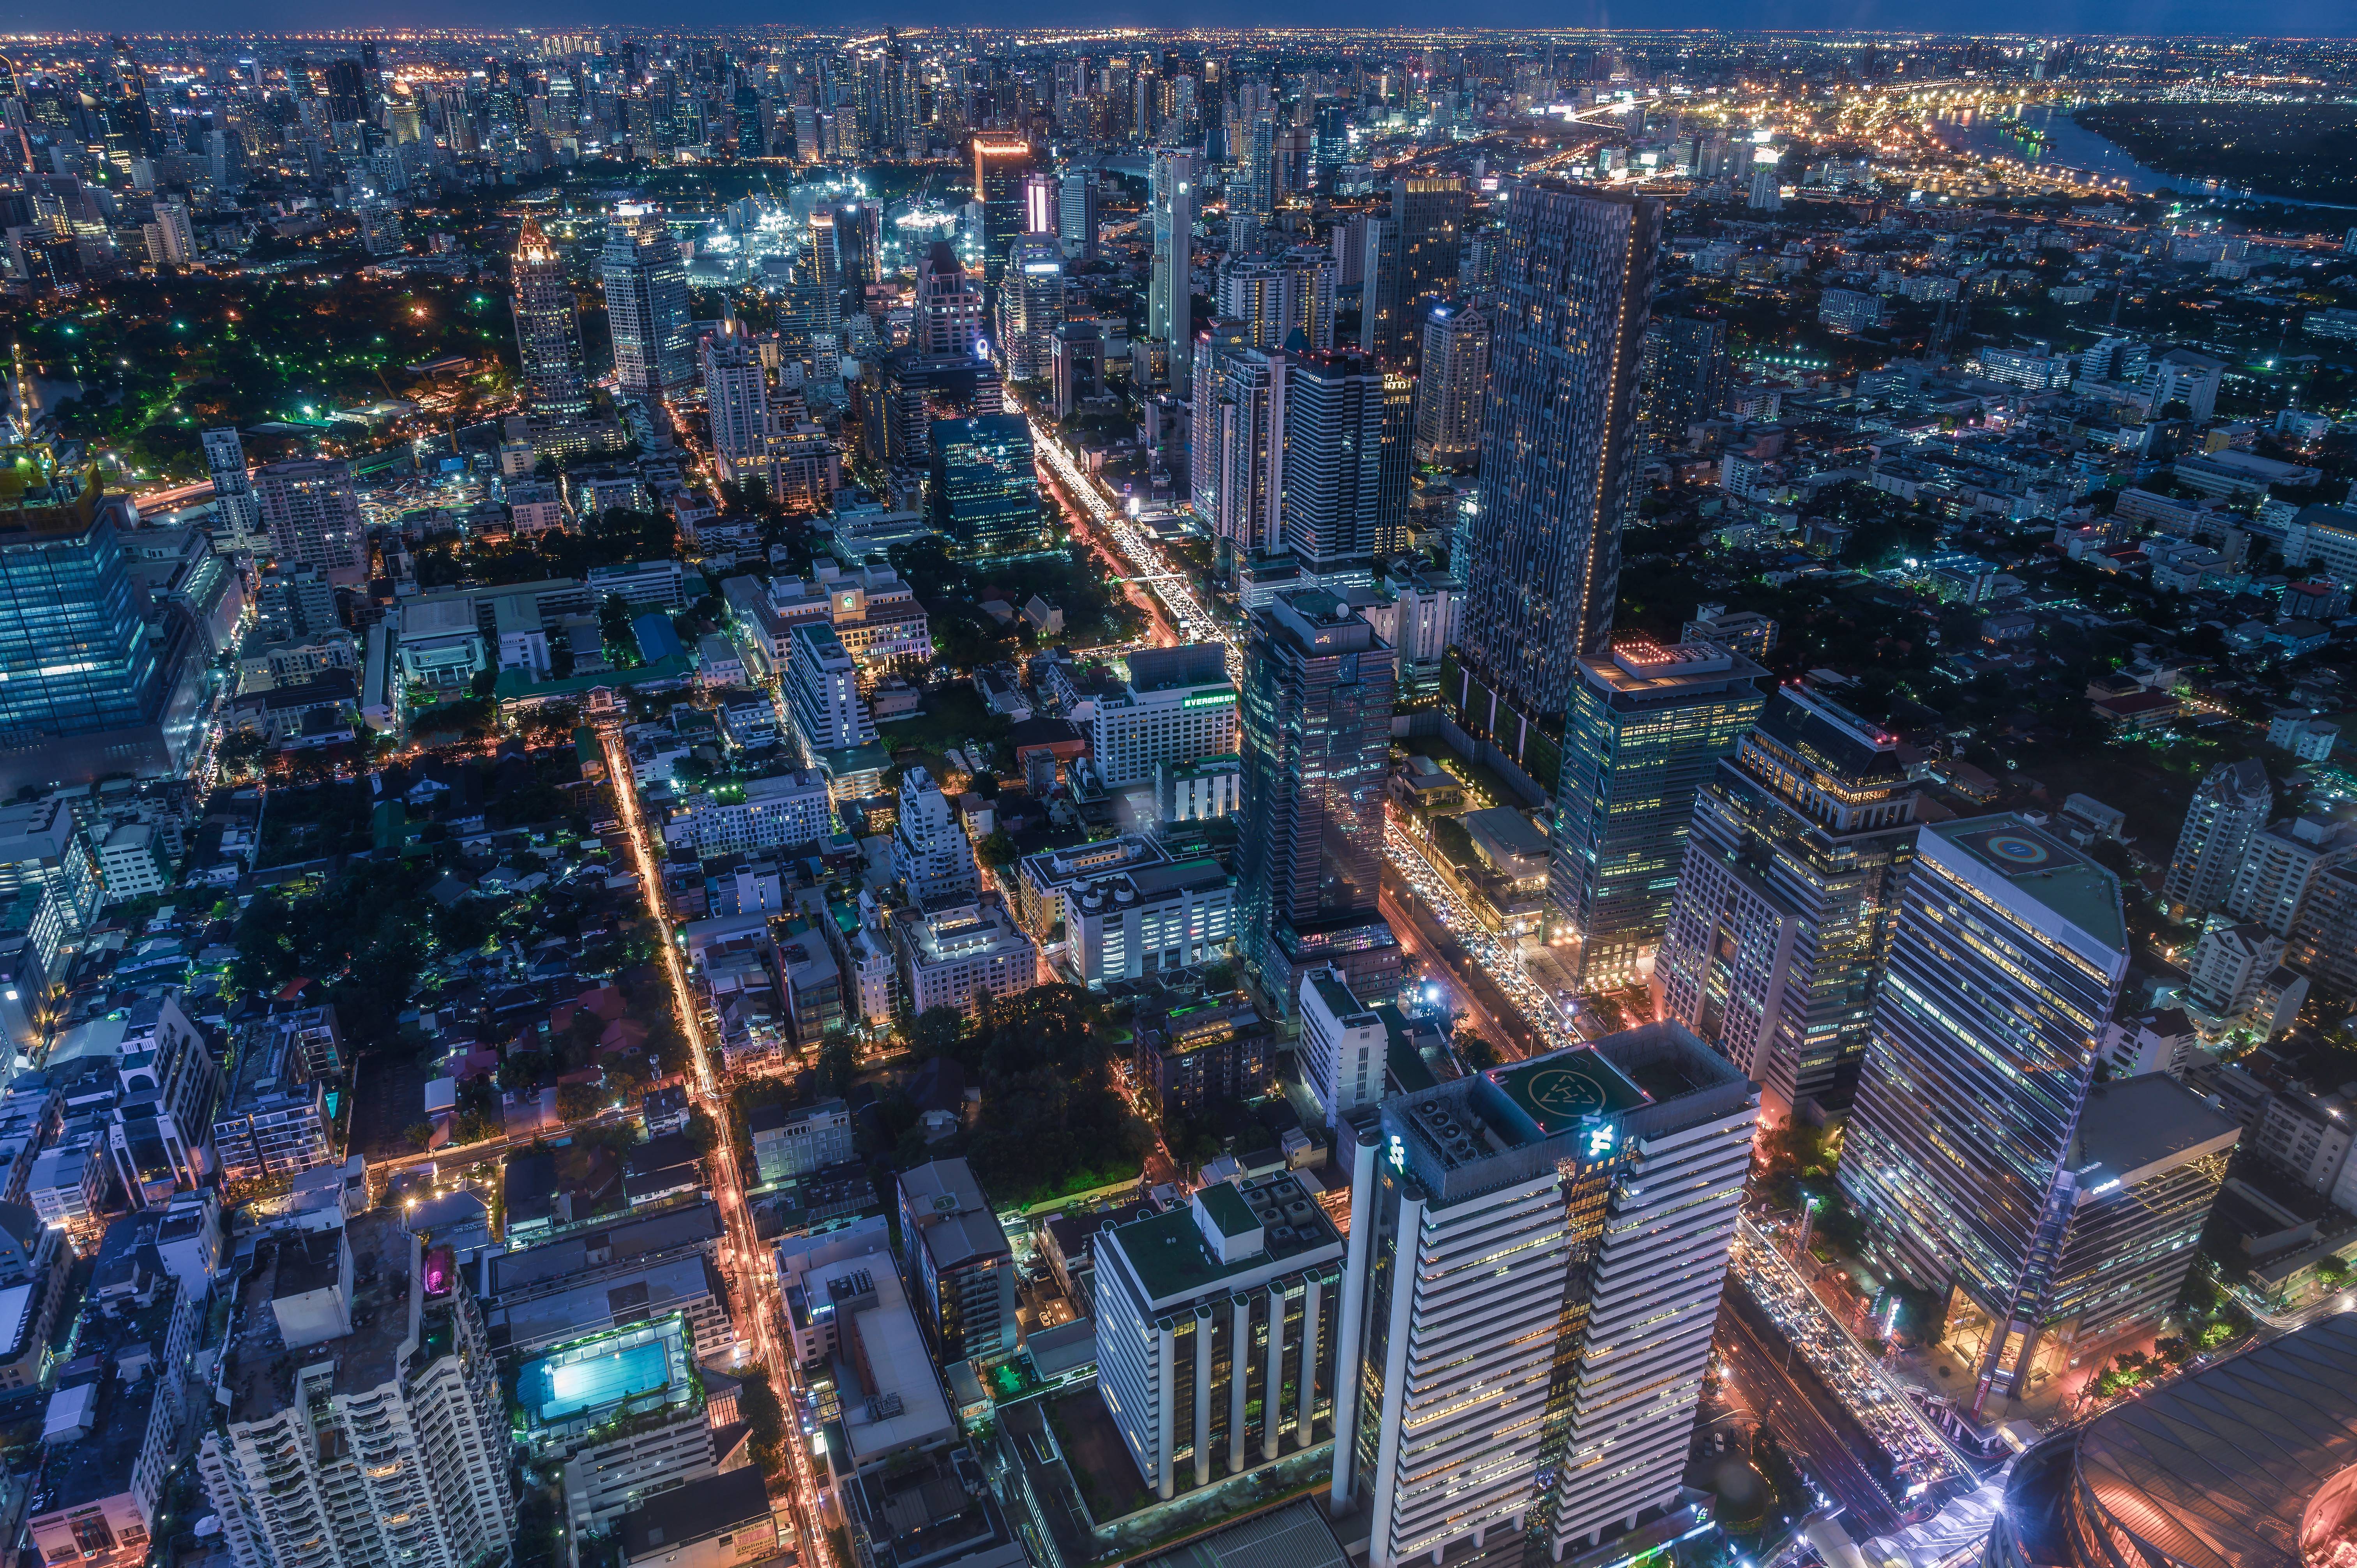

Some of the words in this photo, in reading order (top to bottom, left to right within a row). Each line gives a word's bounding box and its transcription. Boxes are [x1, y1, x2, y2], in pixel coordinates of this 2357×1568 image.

[1309, 374, 1322, 384] ASCOTT
[1185, 694, 1236, 706] EVERGREEN
[1974, 1393, 1983, 1411] Thailand
[742, 1541, 763, 1550] Online
